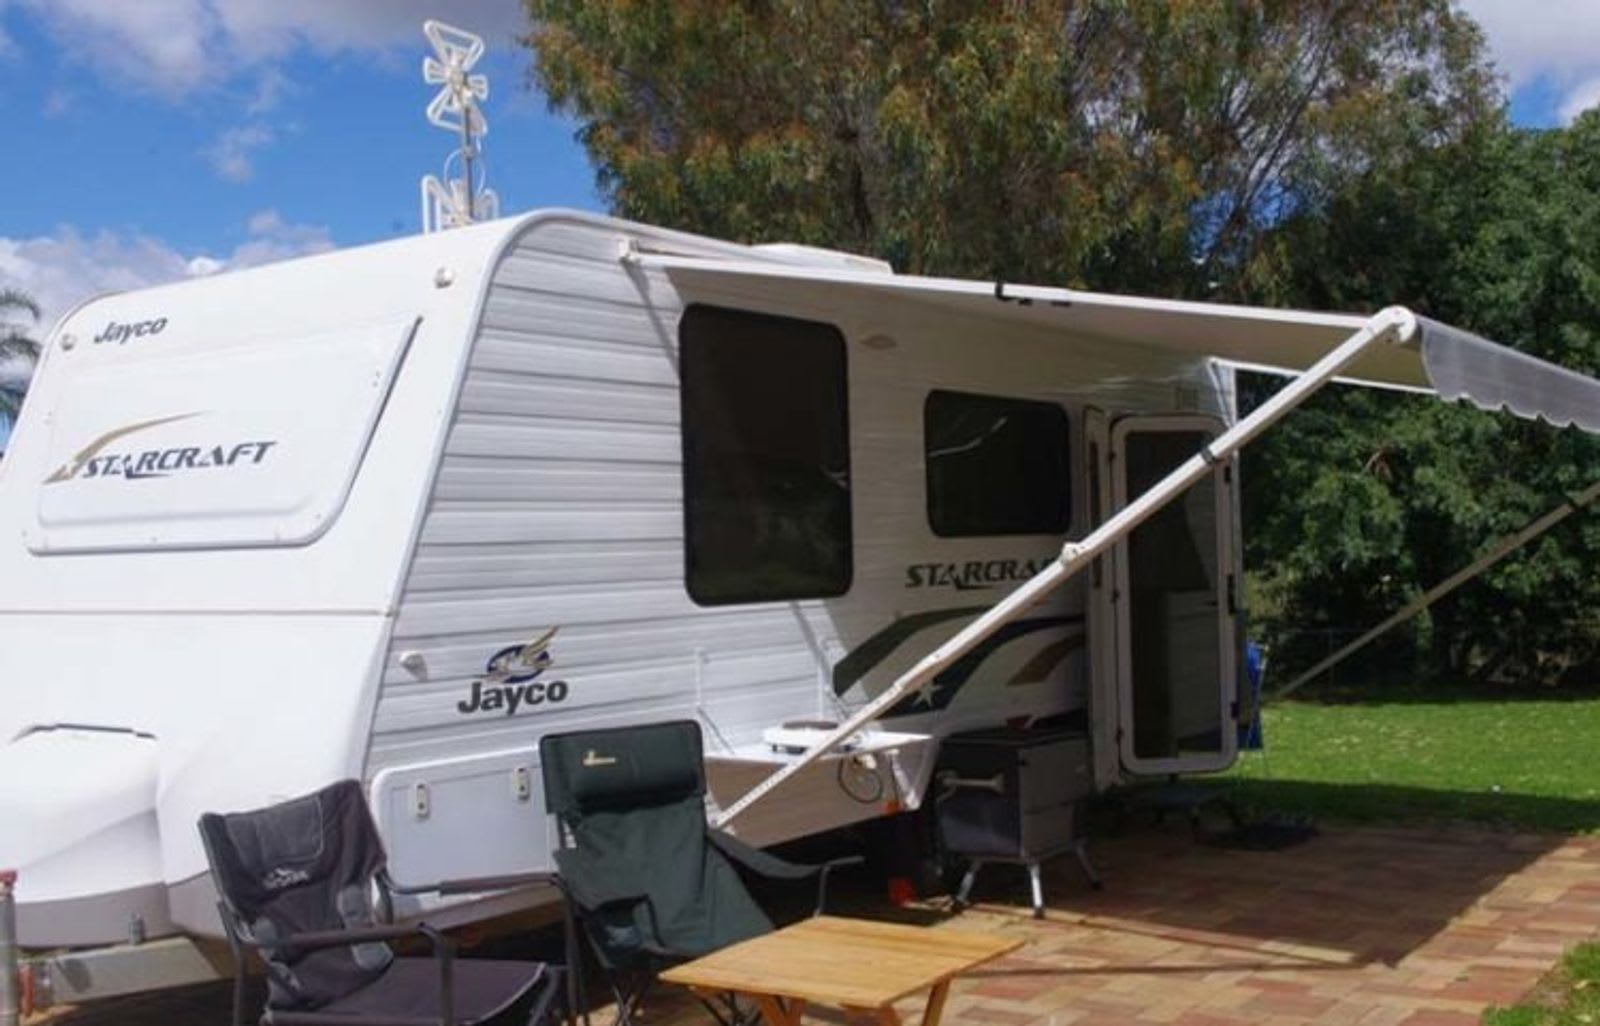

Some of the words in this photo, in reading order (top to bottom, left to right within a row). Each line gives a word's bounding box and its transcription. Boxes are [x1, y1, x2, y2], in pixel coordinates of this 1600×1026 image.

[93, 317, 169, 346] Jayco
[82, 441, 278, 480] STARCRAFT
[904, 556, 1057, 591] STARCRA
[457, 680, 569, 717] Jayco
